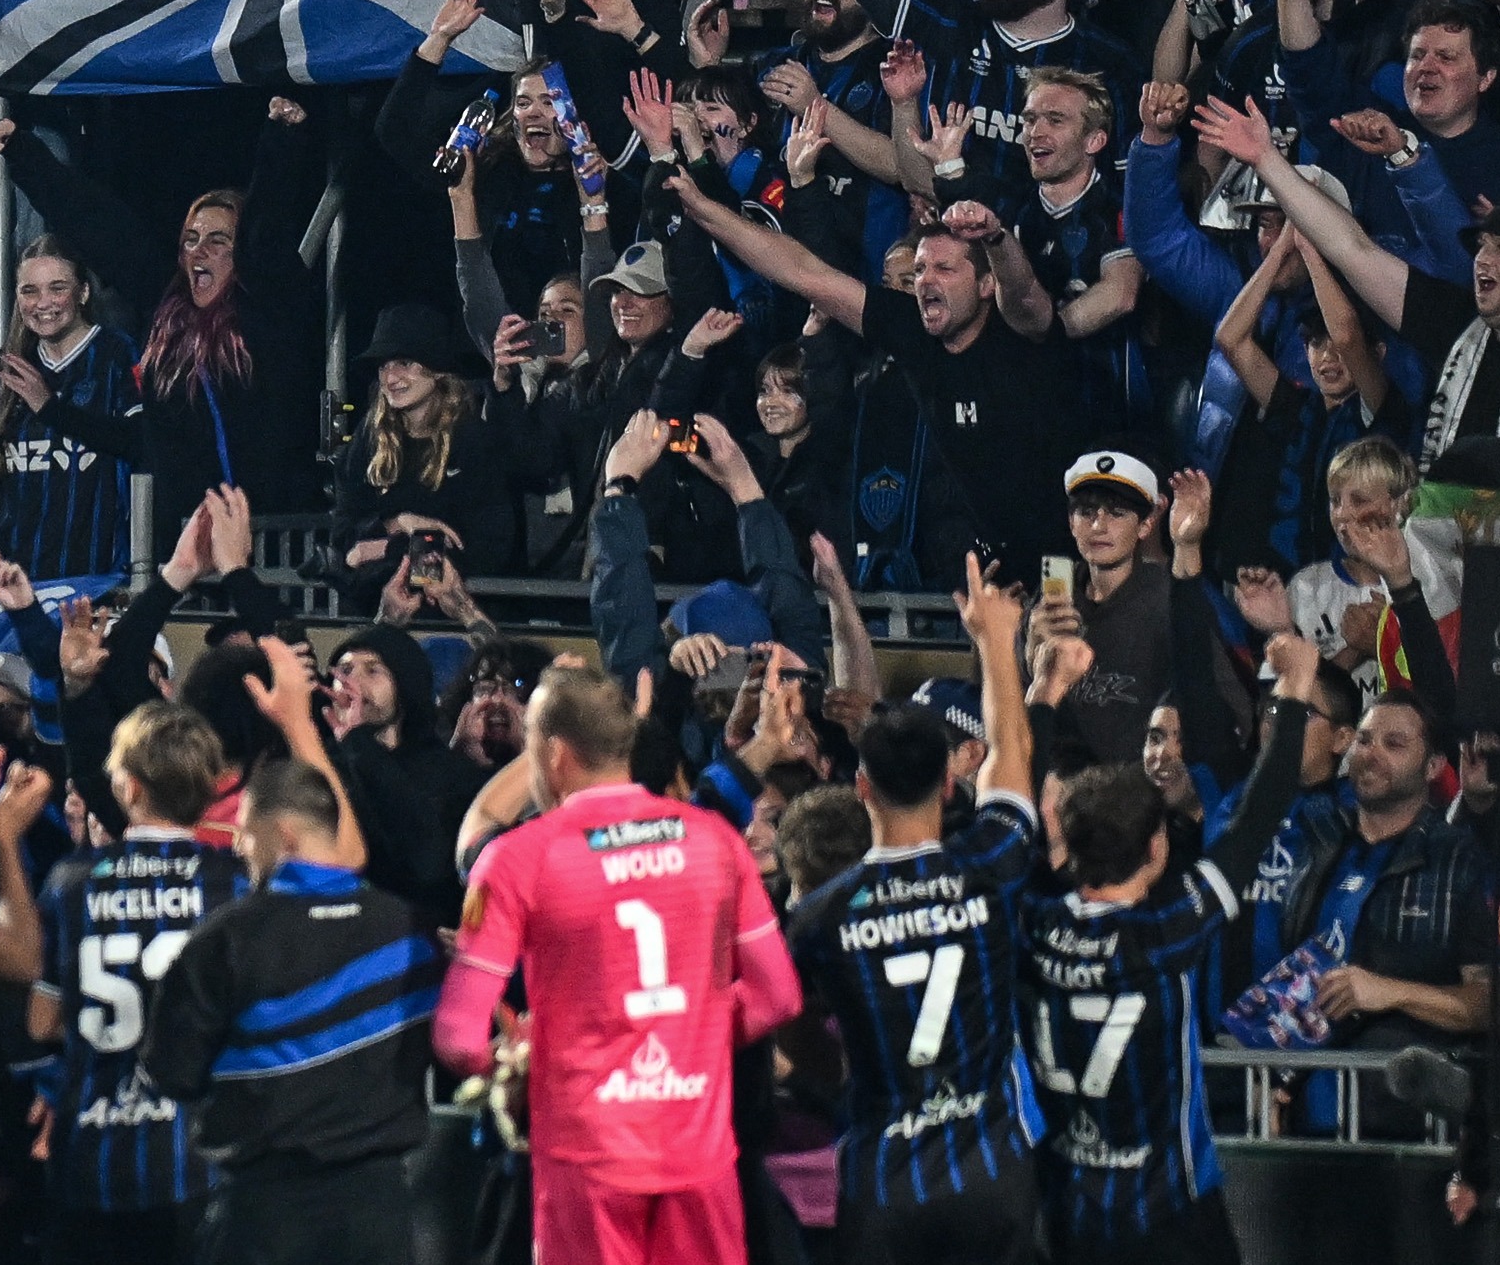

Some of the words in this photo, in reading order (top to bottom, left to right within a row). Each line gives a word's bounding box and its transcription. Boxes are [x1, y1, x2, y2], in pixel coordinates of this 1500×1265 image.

[600, 844, 686, 883] WOUD
[86, 885, 205, 923] VICELICH
[875, 872, 965, 906] Liberty
[839, 894, 990, 953] HOWIESON
[614, 898, 688, 1019] 1
[79, 930, 194, 1054] 5
[883, 942, 966, 1069] 7
[595, 1068, 708, 1103] Anchor
